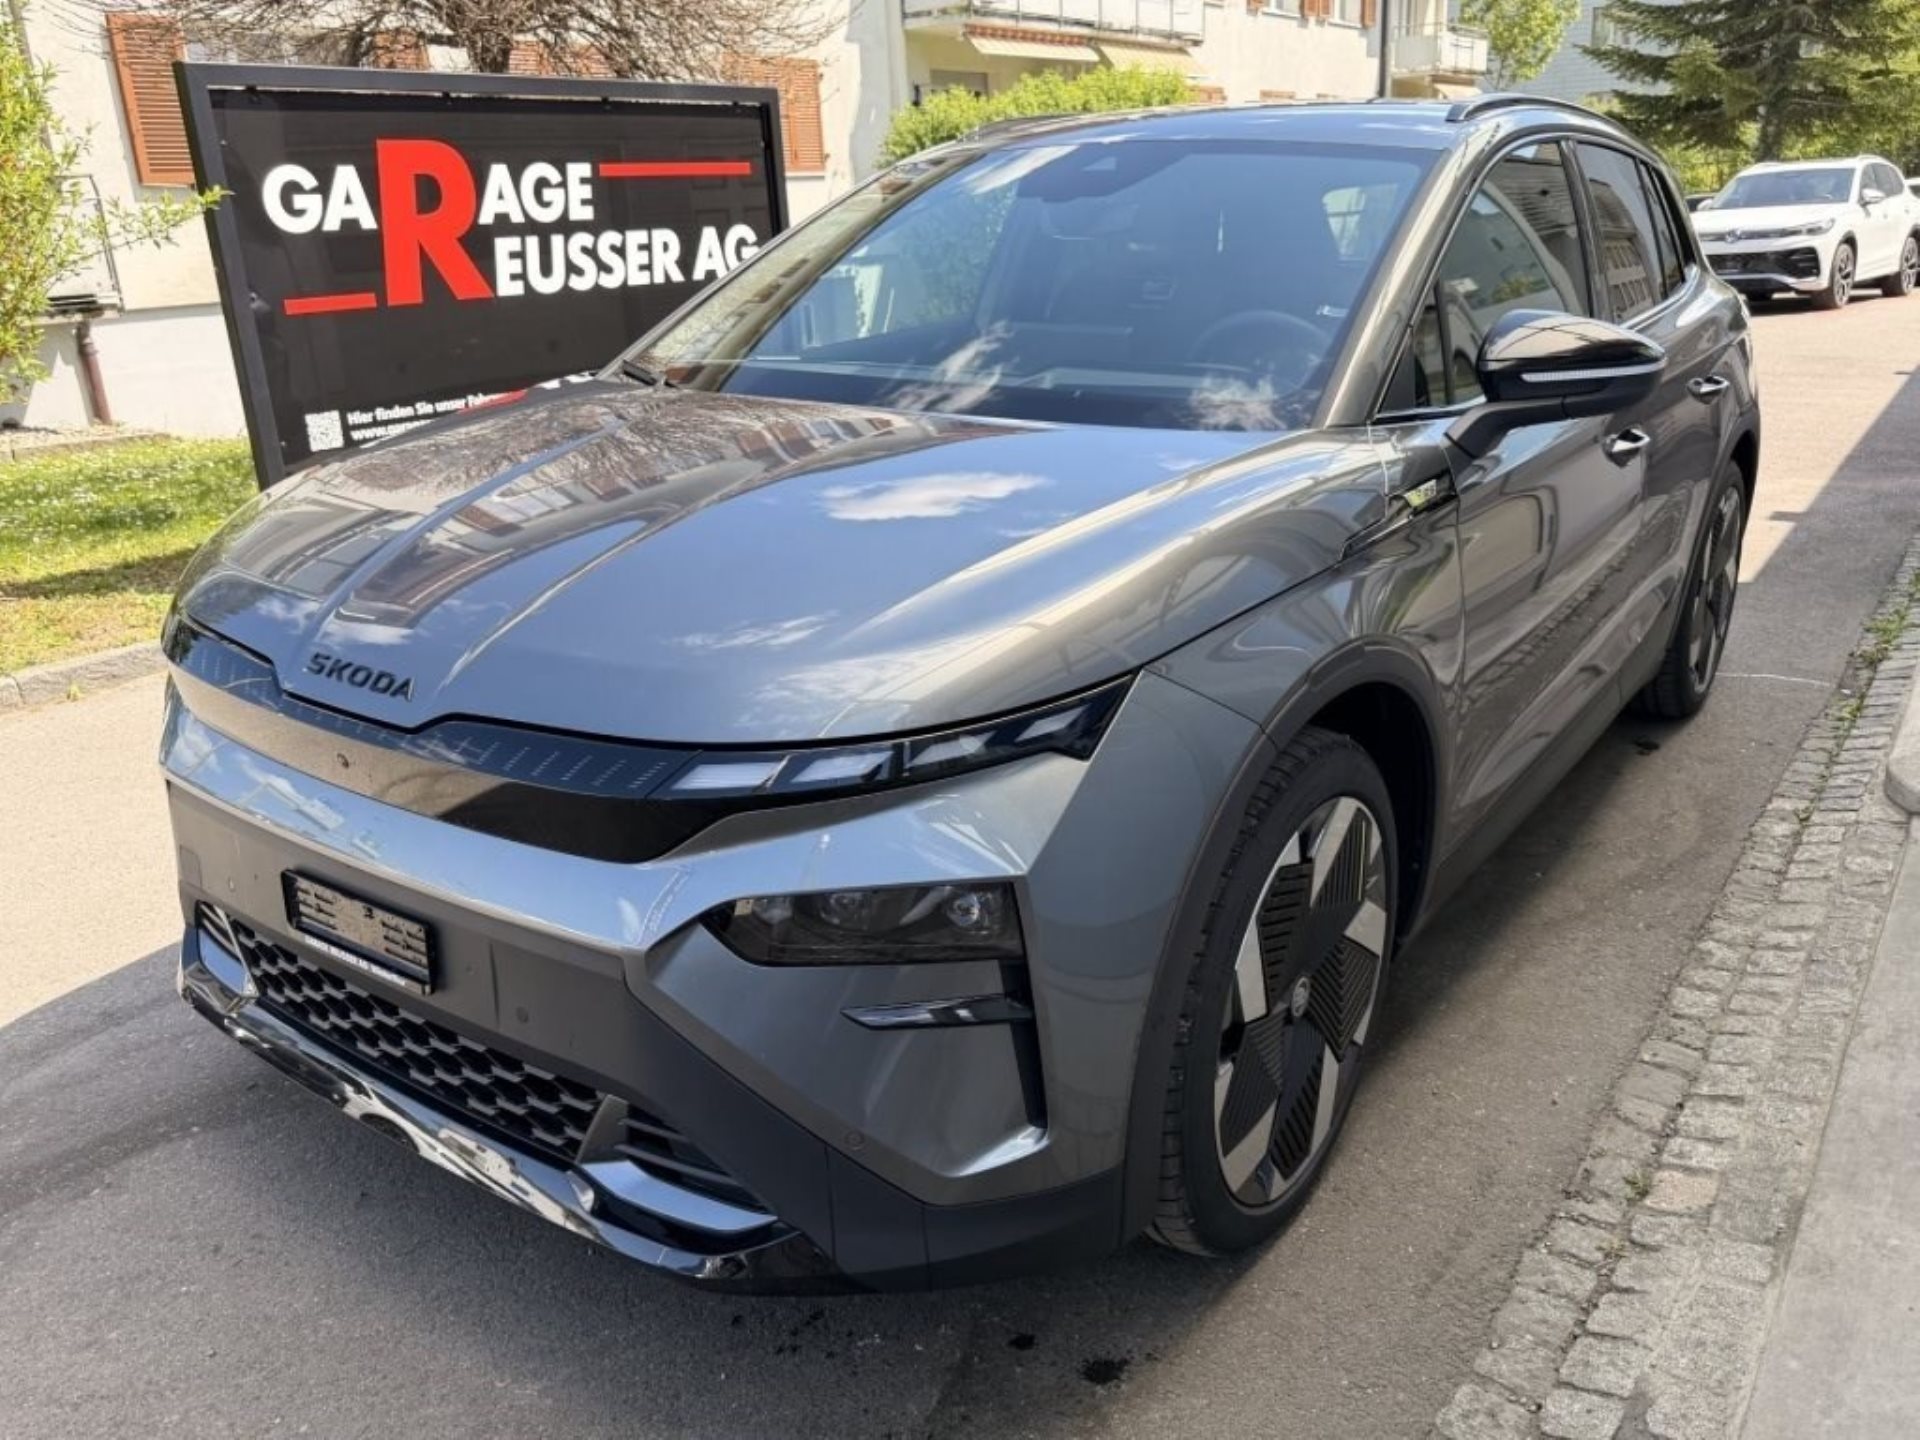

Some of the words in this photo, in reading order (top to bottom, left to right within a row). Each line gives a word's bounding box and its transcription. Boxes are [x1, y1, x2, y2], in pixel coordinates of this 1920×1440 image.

[262, 139, 594, 306] GARAGE
[692, 223, 761, 282] AG
[346, 410, 374, 425] Hier
[374, 404, 415, 421] finden
[415, 401, 434, 416] Sie
